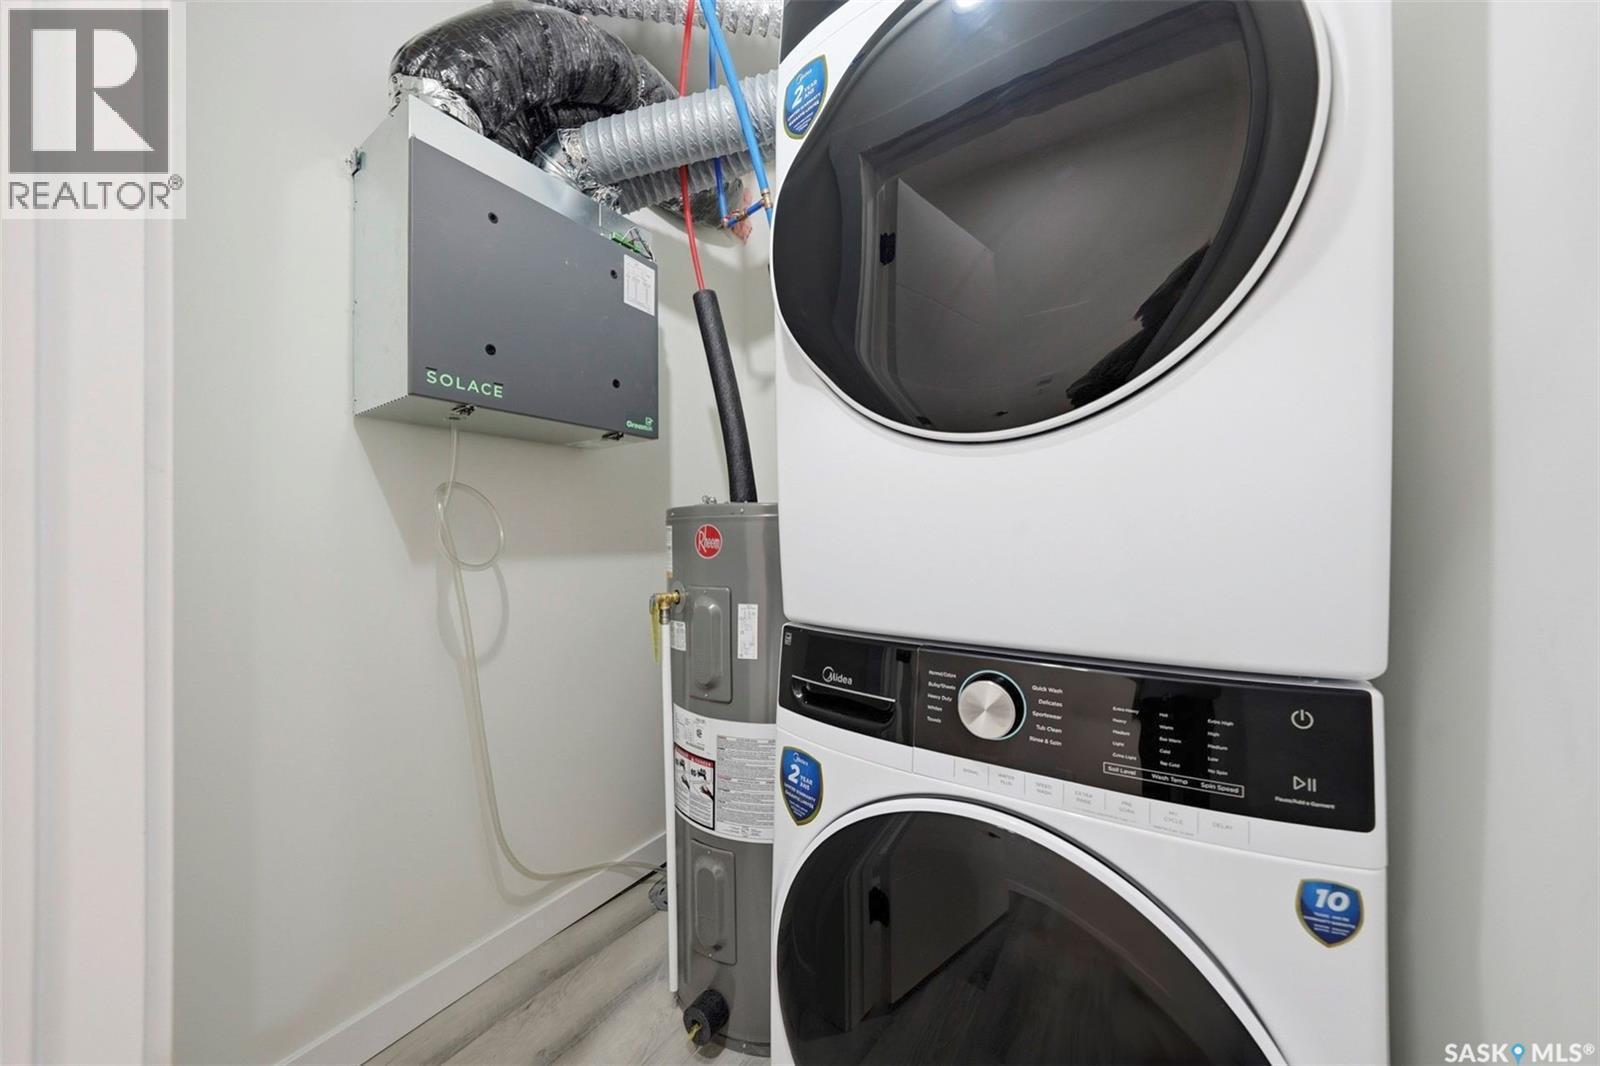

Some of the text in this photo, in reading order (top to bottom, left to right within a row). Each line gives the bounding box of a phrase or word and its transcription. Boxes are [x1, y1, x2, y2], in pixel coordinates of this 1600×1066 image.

[792, 85, 804, 109] 2
[426, 370, 503, 398] SOLACE
[697, 525, 720, 553] Rheem
[822, 666, 853, 685] Midea
[1031, 684, 1063, 694] Quick Wash
[1038, 699, 1063, 707] Delicates
[1032, 711, 1062, 720] Sportswear
[1047, 725, 1062, 734] Clean
[1029, 736, 1044, 744] Rinse
[1050, 738, 1062, 746] Spin
[788, 763, 801, 785] 2
[1107, 765, 1240, 794] Soil Level Wash Temp Spin Speed
[1314, 888, 1350, 913] 10
